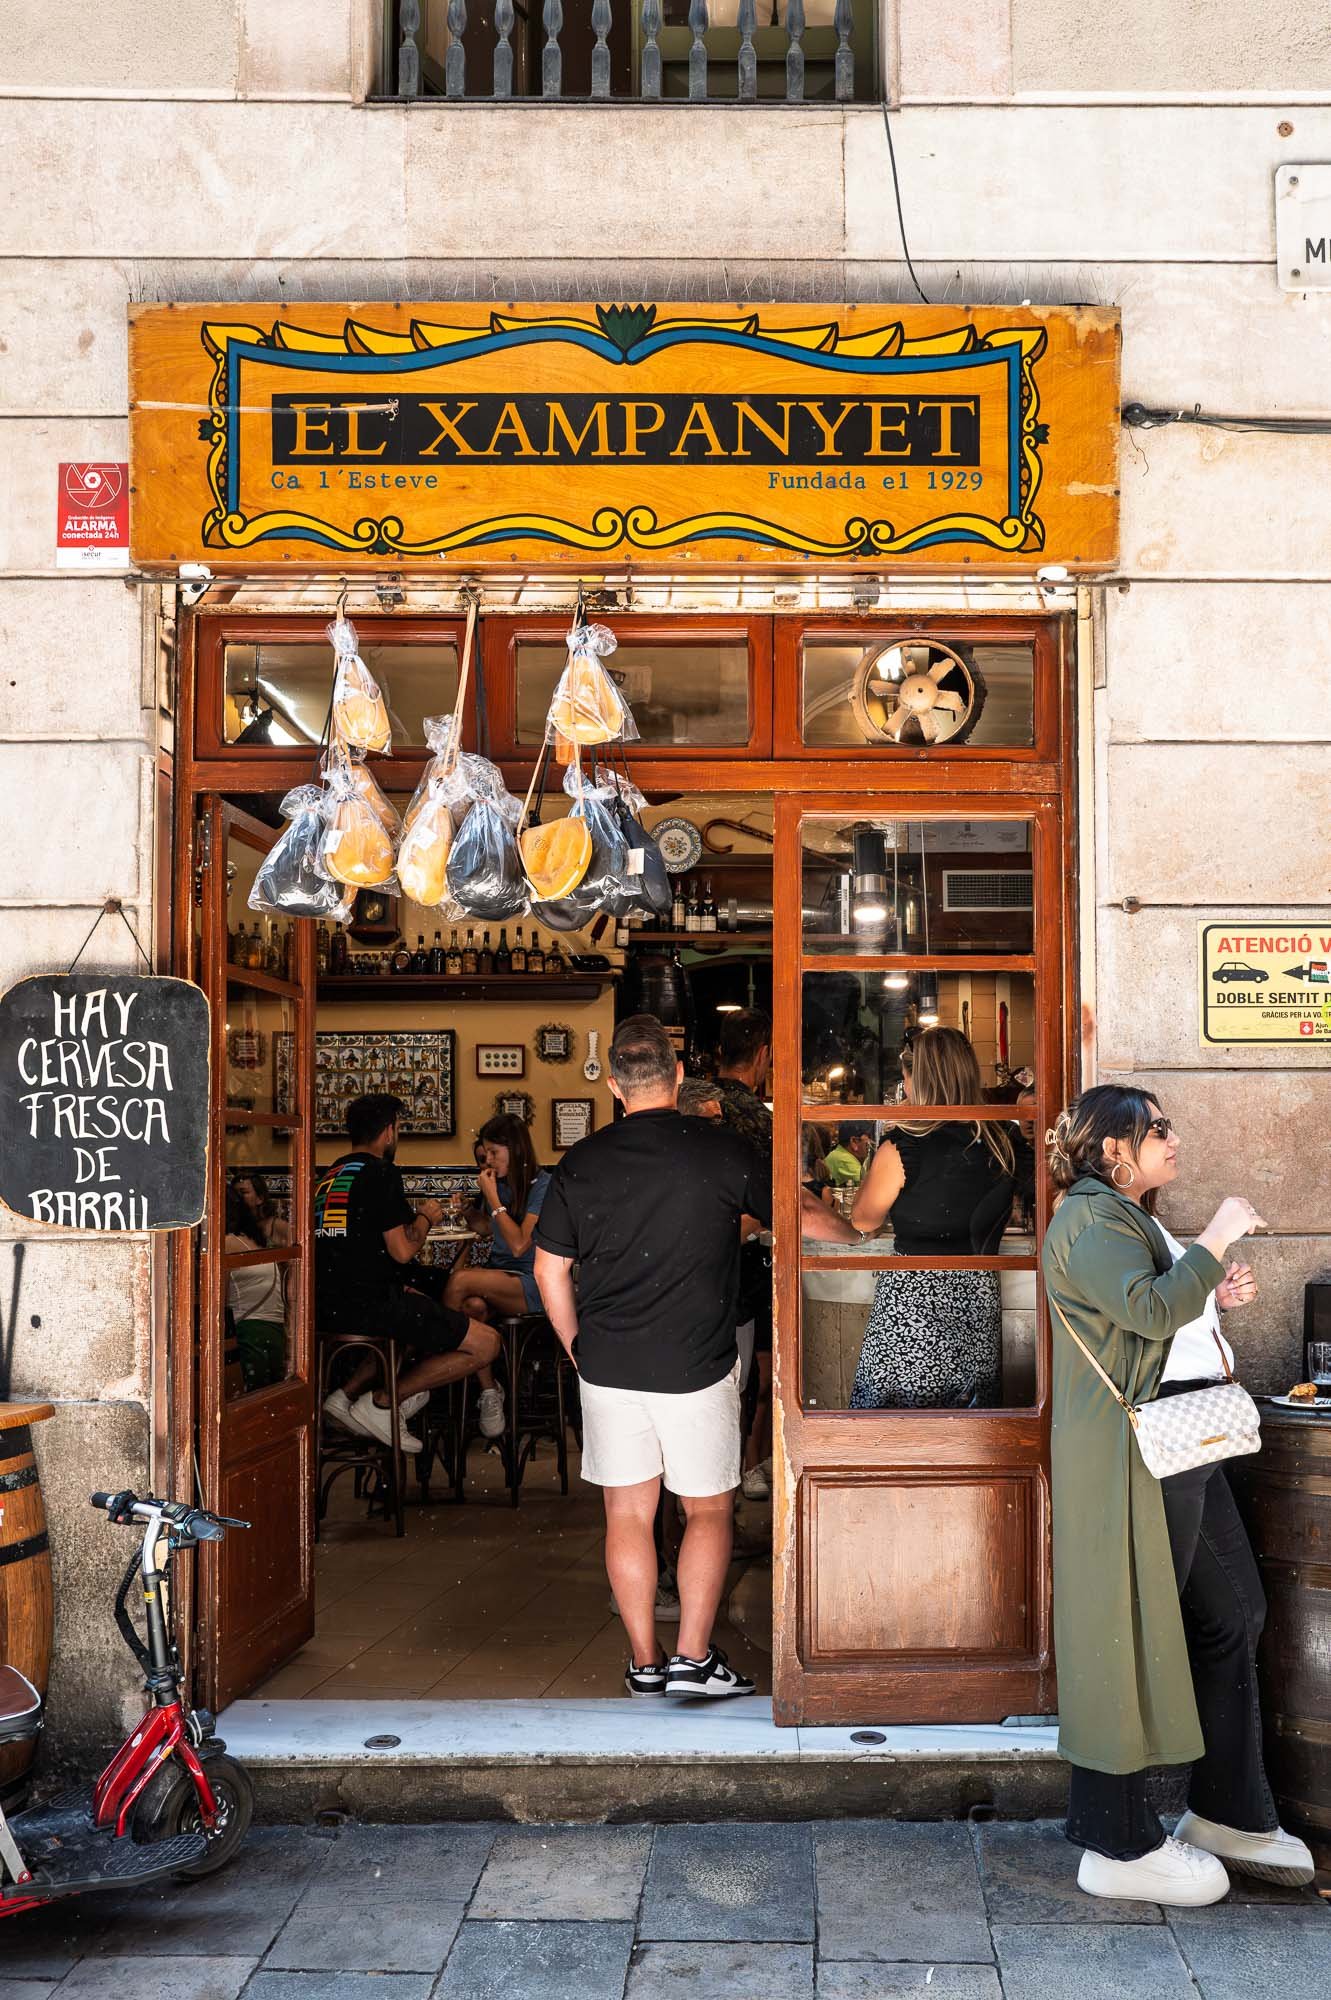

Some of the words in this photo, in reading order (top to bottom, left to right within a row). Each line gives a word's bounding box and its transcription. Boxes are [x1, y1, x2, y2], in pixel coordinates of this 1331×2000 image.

[1305, 237, 1331, 263] M
[288, 402, 388, 456] EL
[418, 400, 976, 457] XAMPANYET
[270, 471, 300, 489] Ca
[768, 471, 866, 490] Fundada
[927, 471, 983, 491] 1929
[62, 531, 103, 539] conectada
[104, 531, 120, 539] 24h
[64, 520, 118, 531] ALARMA
[1217, 933, 1312, 953] ATENCIÓ
[1216, 992, 1264, 1004] DOBLE
[1268, 992, 1320, 1004] SENTIT
[53, 988, 138, 1038] HAY
[1290, 1011, 1302, 1019] PER
[1303, 1011, 1312, 1019] LA
[17, 1037, 174, 1092] CERVESA
[18, 1091, 171, 1145] FRESCA
[73, 1146, 121, 1184] DE
